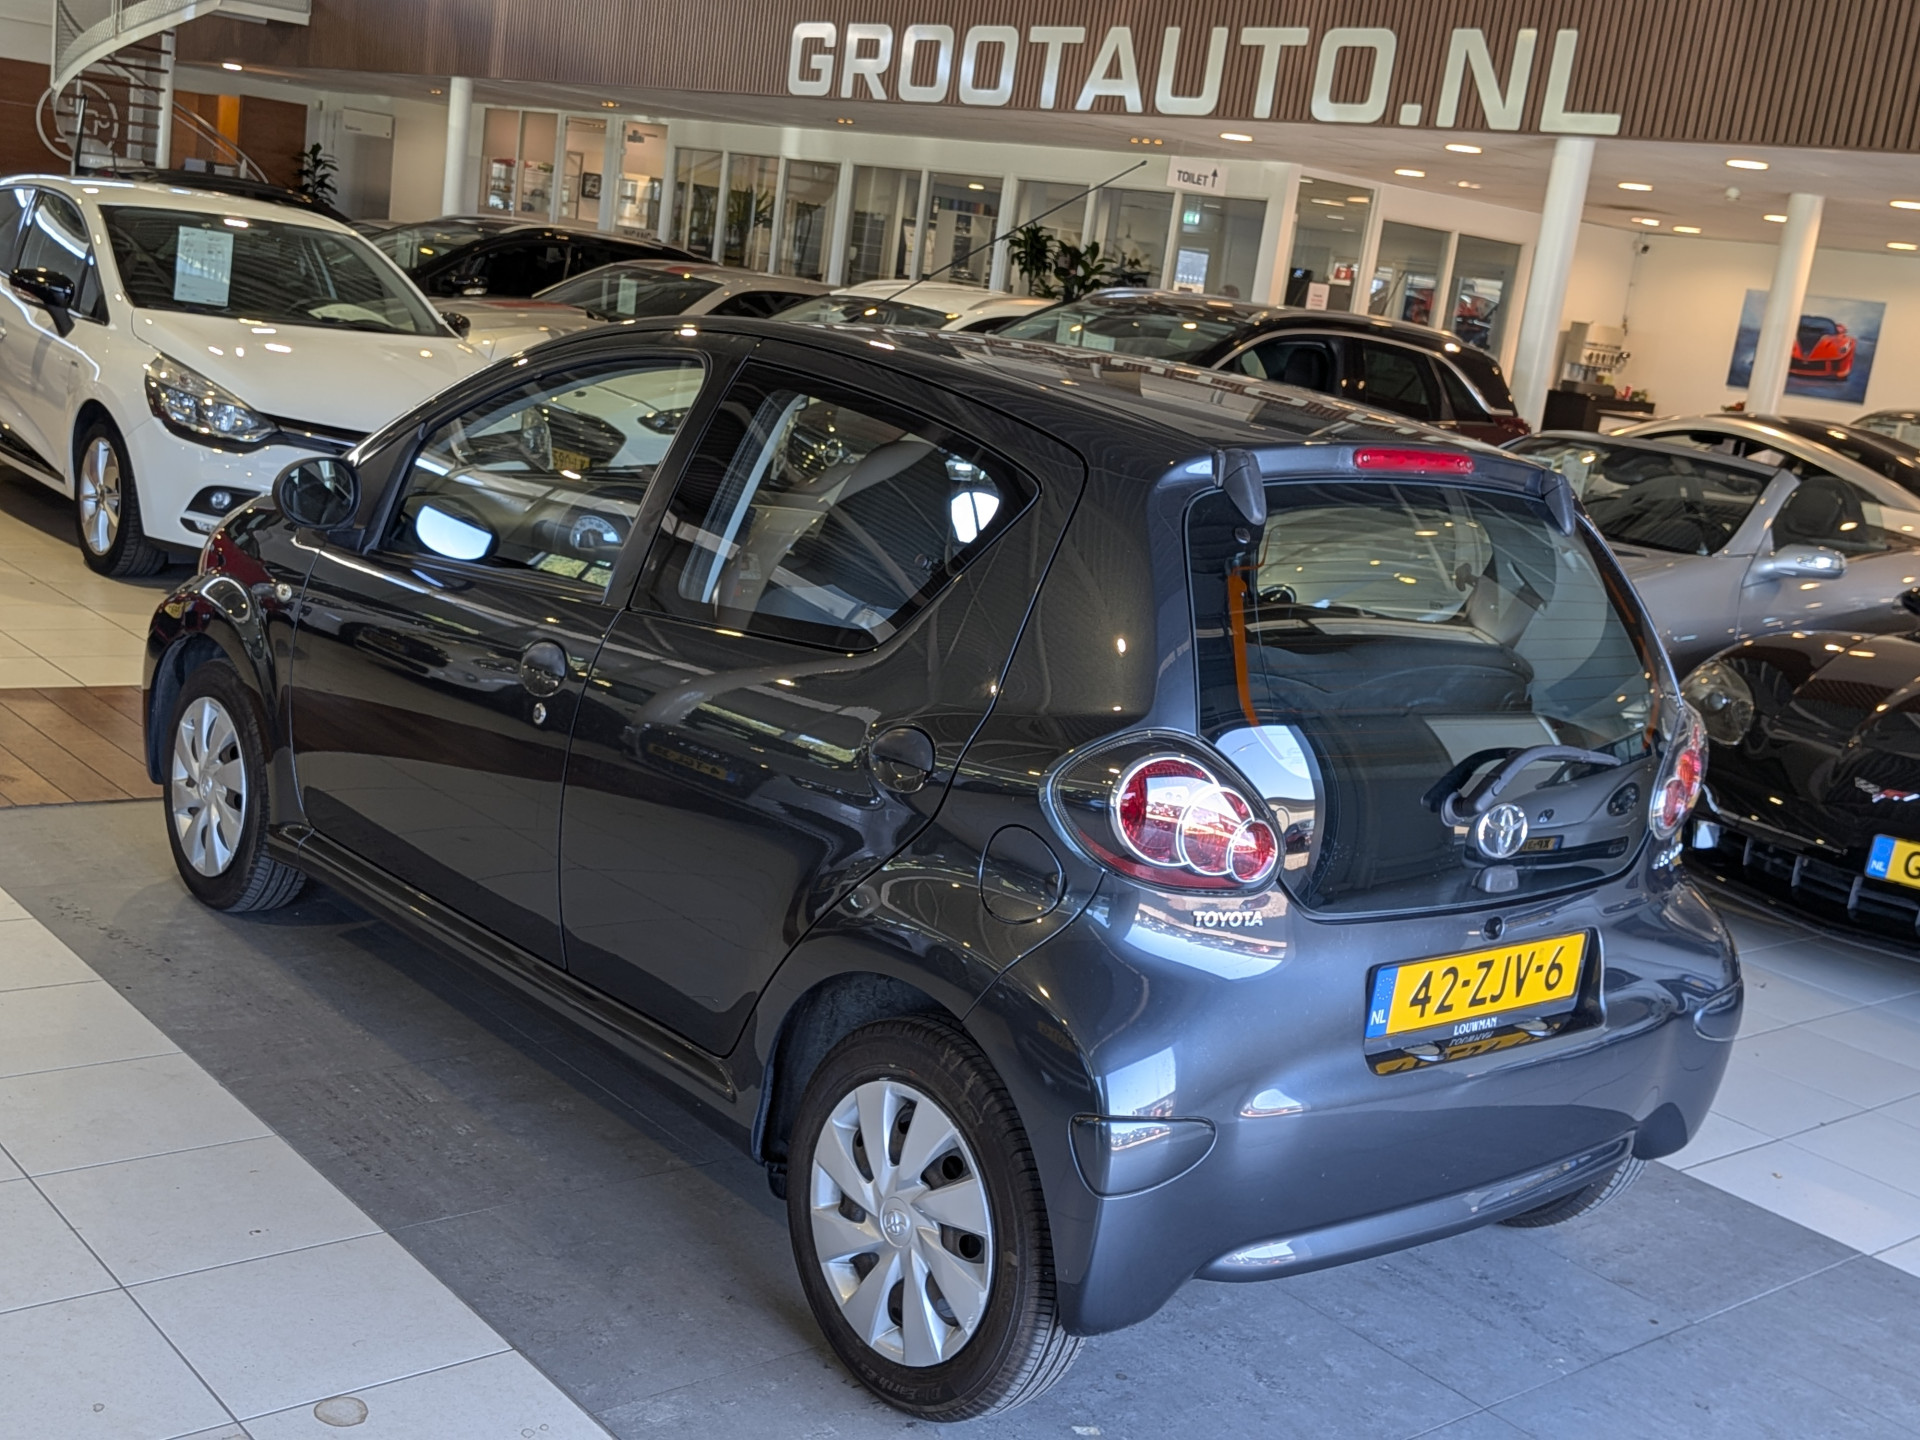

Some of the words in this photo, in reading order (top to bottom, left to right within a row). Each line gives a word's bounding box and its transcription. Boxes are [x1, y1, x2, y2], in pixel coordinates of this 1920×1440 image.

[788, 22, 1621, 135] GROOTAUTO.NL
[1177, 170, 1209, 186] TOILET
[1870, 860, 1886, 872] NL
[1193, 911, 1263, 927] TOYOTA
[1410, 945, 1564, 1018] 42-ZJV-6
[1371, 1010, 1386, 1026] NL
[1453, 1017, 1497, 1035] LOUWMAN
